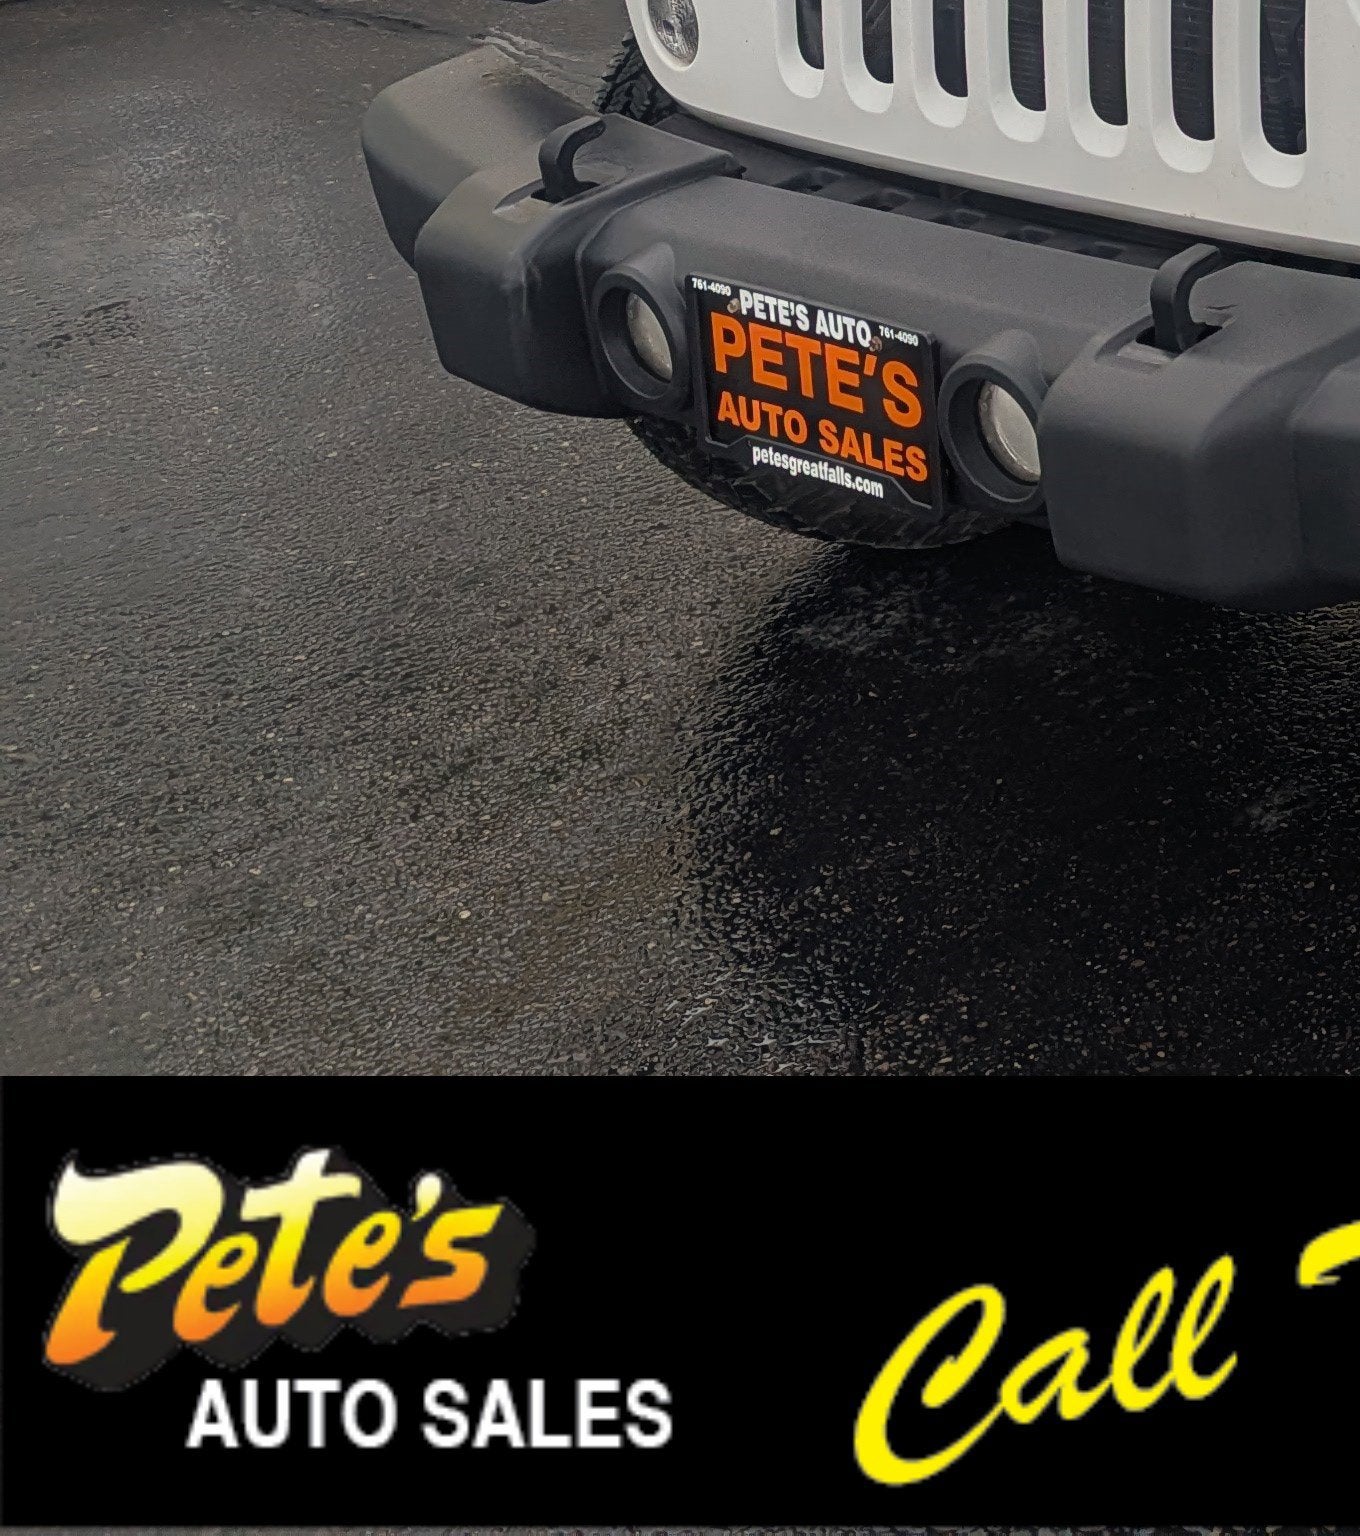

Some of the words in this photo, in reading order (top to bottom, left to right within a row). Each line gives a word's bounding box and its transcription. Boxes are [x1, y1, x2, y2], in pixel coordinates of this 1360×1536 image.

[692, 277, 731, 297] 761-4090
[739, 289, 810, 332] PETE'S
[815, 309, 873, 348] AUTO
[878, 325, 919, 347] 761-4090
[711, 311, 923, 428] PETE'S
[717, 390, 808, 445] AUTO
[818, 419, 928, 482] SALES
[752, 445, 884, 499] petesgreatfalls.com
